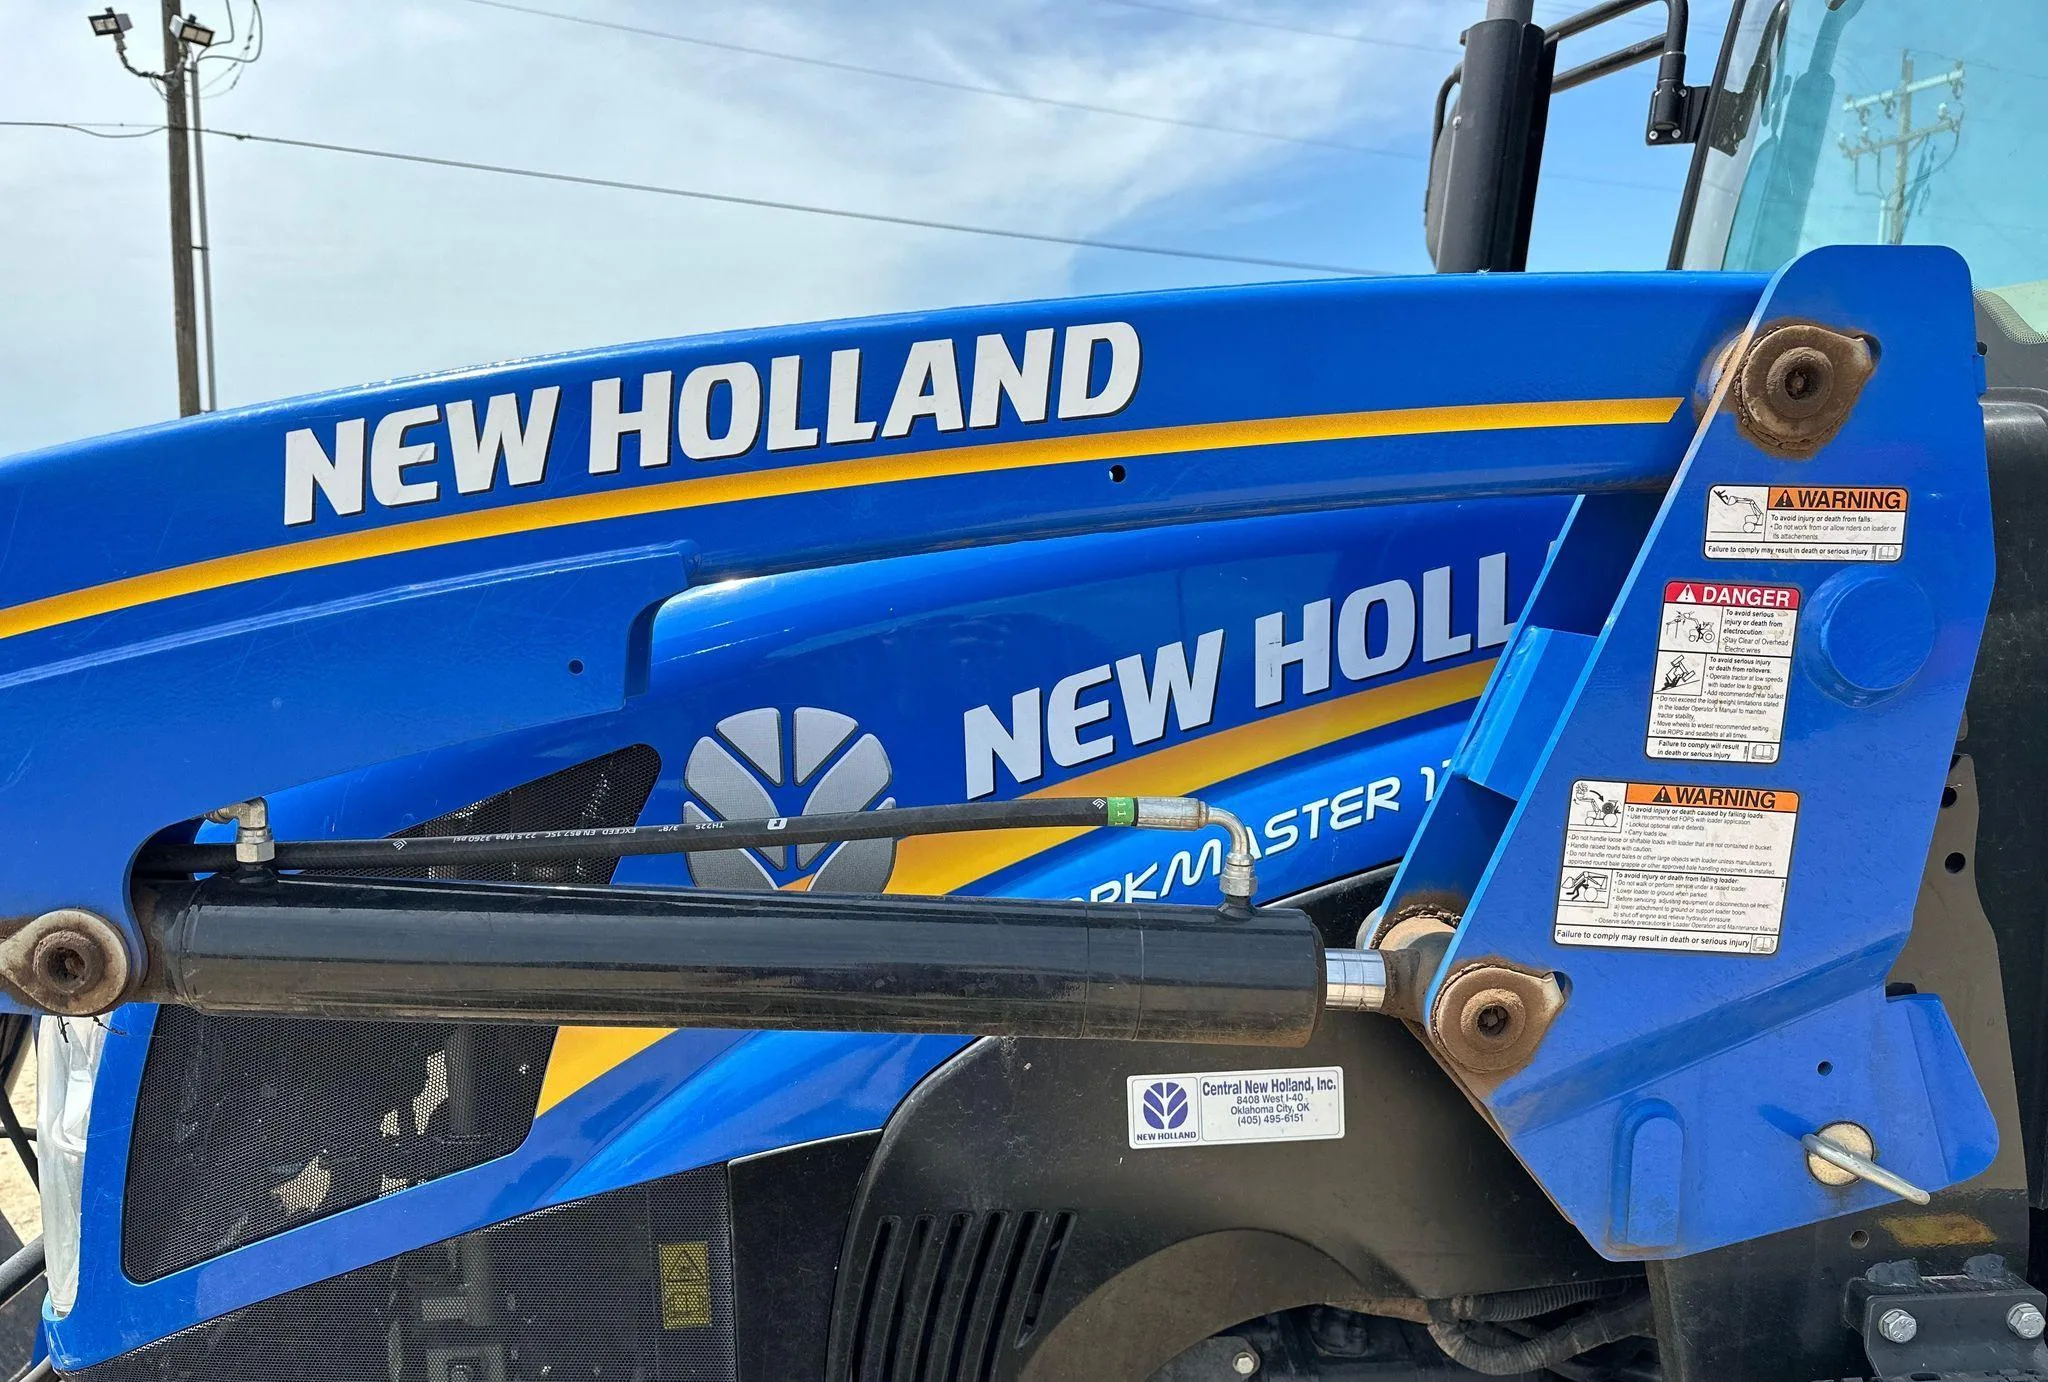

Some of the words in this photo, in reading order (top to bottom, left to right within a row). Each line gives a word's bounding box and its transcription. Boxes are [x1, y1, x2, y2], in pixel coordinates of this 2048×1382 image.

[283, 386, 560, 526] NEW
[589, 321, 1142, 475] HOLLAND
[1796, 489, 1901, 509] WARNING
[1796, 514, 1815, 523] injury
[1736, 545, 1760, 554] comply
[1849, 547, 1868, 556] injury
[1701, 586, 1790, 607] DANGER
[1723, 617, 1742, 626] injury
[1754, 658, 1771, 667] injury
[963, 628, 1225, 801] NEW
[1255, 541, 1558, 708] HOLL
[1686, 741, 1710, 750] comply
[1712, 751, 1731, 759] injury
[1675, 786, 1776, 809] WARNING
[1634, 805, 1653, 813] avoid
[1652, 806, 1671, 816] injury
[1678, 807, 1696, 816] death
[1695, 808, 1719, 817] caused
[1718, 810, 1727, 819] by
[1726, 810, 1747, 820] falling
[1069, 777, 1400, 903] RKMSTER
[1623, 871, 1641, 879] avoid
[1640, 872, 1659, 882] injury
[1666, 873, 1684, 881] death
[1698, 875, 1718, 885] falling
[1555, 929, 1582, 938] Failure
[1582, 930, 1592, 939] to
[1591, 931, 1620, 942] comply
[1620, 934, 1637, 943] may
[1637, 933, 1660, 942] result
[1659, 934, 1668, 942] in
[1668, 934, 1690, 943] death
[1699, 935, 1728, 945] serious
[1727, 937, 1750, 948] injury
[1202, 1080, 1242, 1096] Central
[1244, 1079, 1268, 1094] New
[1270, 1076, 1314, 1095] Holland,
[1316, 1076, 1336, 1090] Inc.
[1236, 1094, 1260, 1104] 8408
[1261, 1093, 1284, 1103] West
[1285, 1092, 1303, 1102] I-40
[1230, 1104, 1274, 1114] Oklahoma
[1275, 1103, 1294, 1115] City,
[1296, 1102, 1309, 1111] OK
[1237, 1115, 1261, 1126] (405)
[1263, 1113, 1303, 1123] 495-6151
[1136, 1132, 1156, 1141] NEW
[1157, 1130, 1196, 1140] HOLLAND
